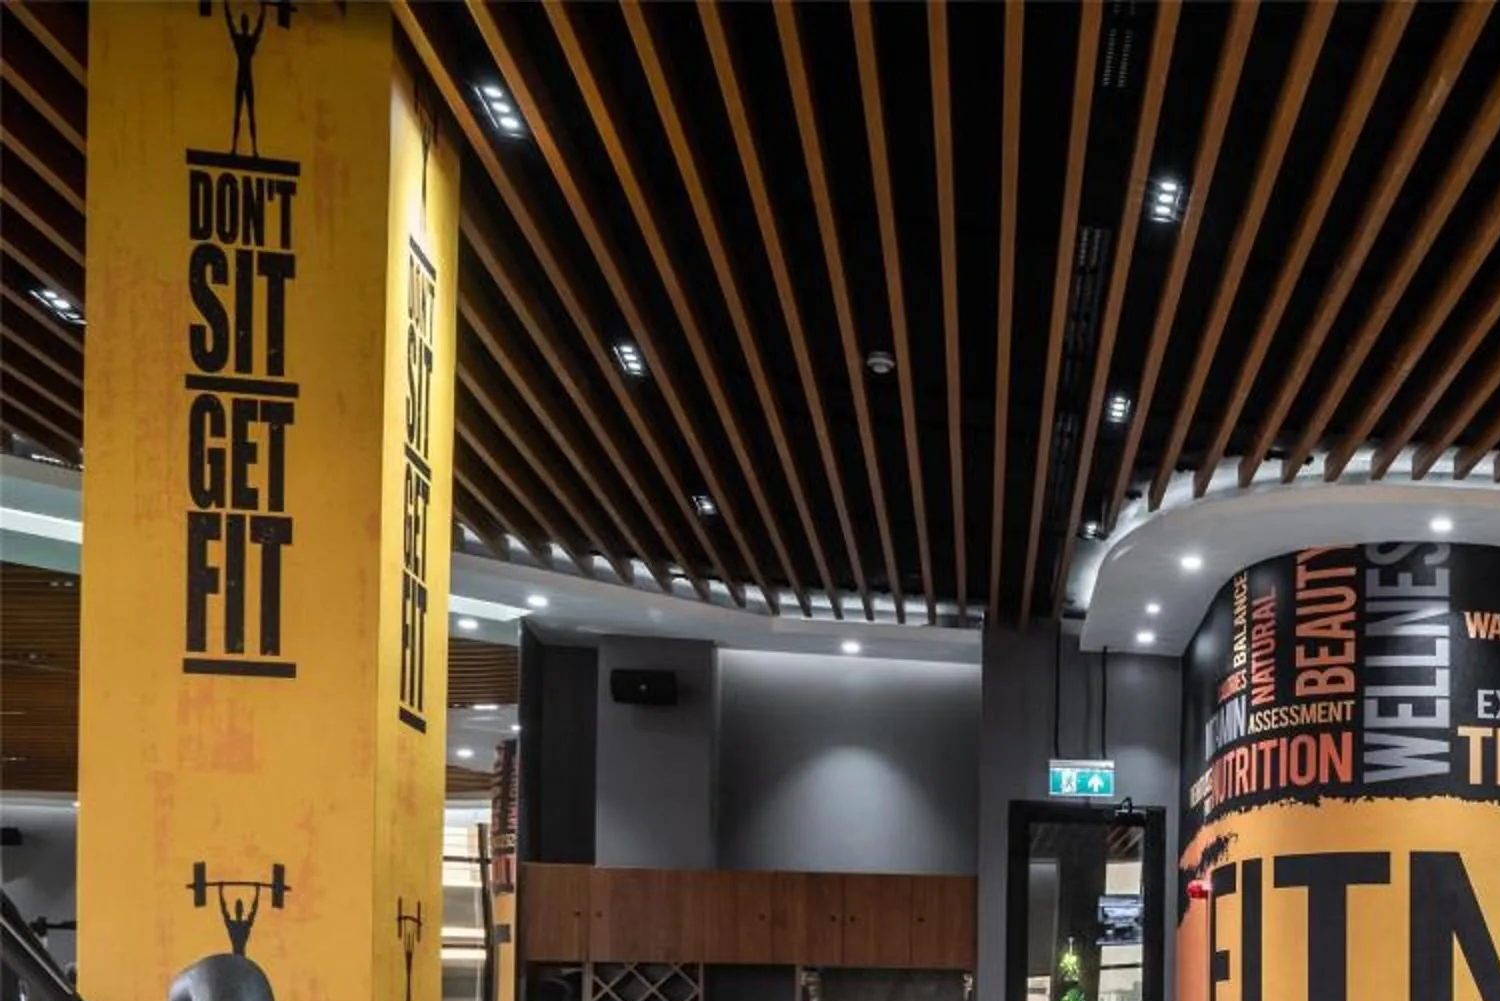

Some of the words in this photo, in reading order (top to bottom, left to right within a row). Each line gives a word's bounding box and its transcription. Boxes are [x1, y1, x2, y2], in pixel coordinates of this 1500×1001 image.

[189, 169, 297, 250] DON'T
[189, 243, 296, 376] SIT
[405, 322, 433, 461] SIT
[188, 393, 294, 512] GET
[403, 462, 430, 584] GET
[185, 511, 293, 657] FIT
[402, 566, 427, 713] FIT
[1234, 572, 1248, 667] BALANCE
[1252, 585, 1277, 705] NATURAL
[1211, 732, 1353, 808] NUTRITION
[1248, 701, 1355, 735] ASSESSMENT
